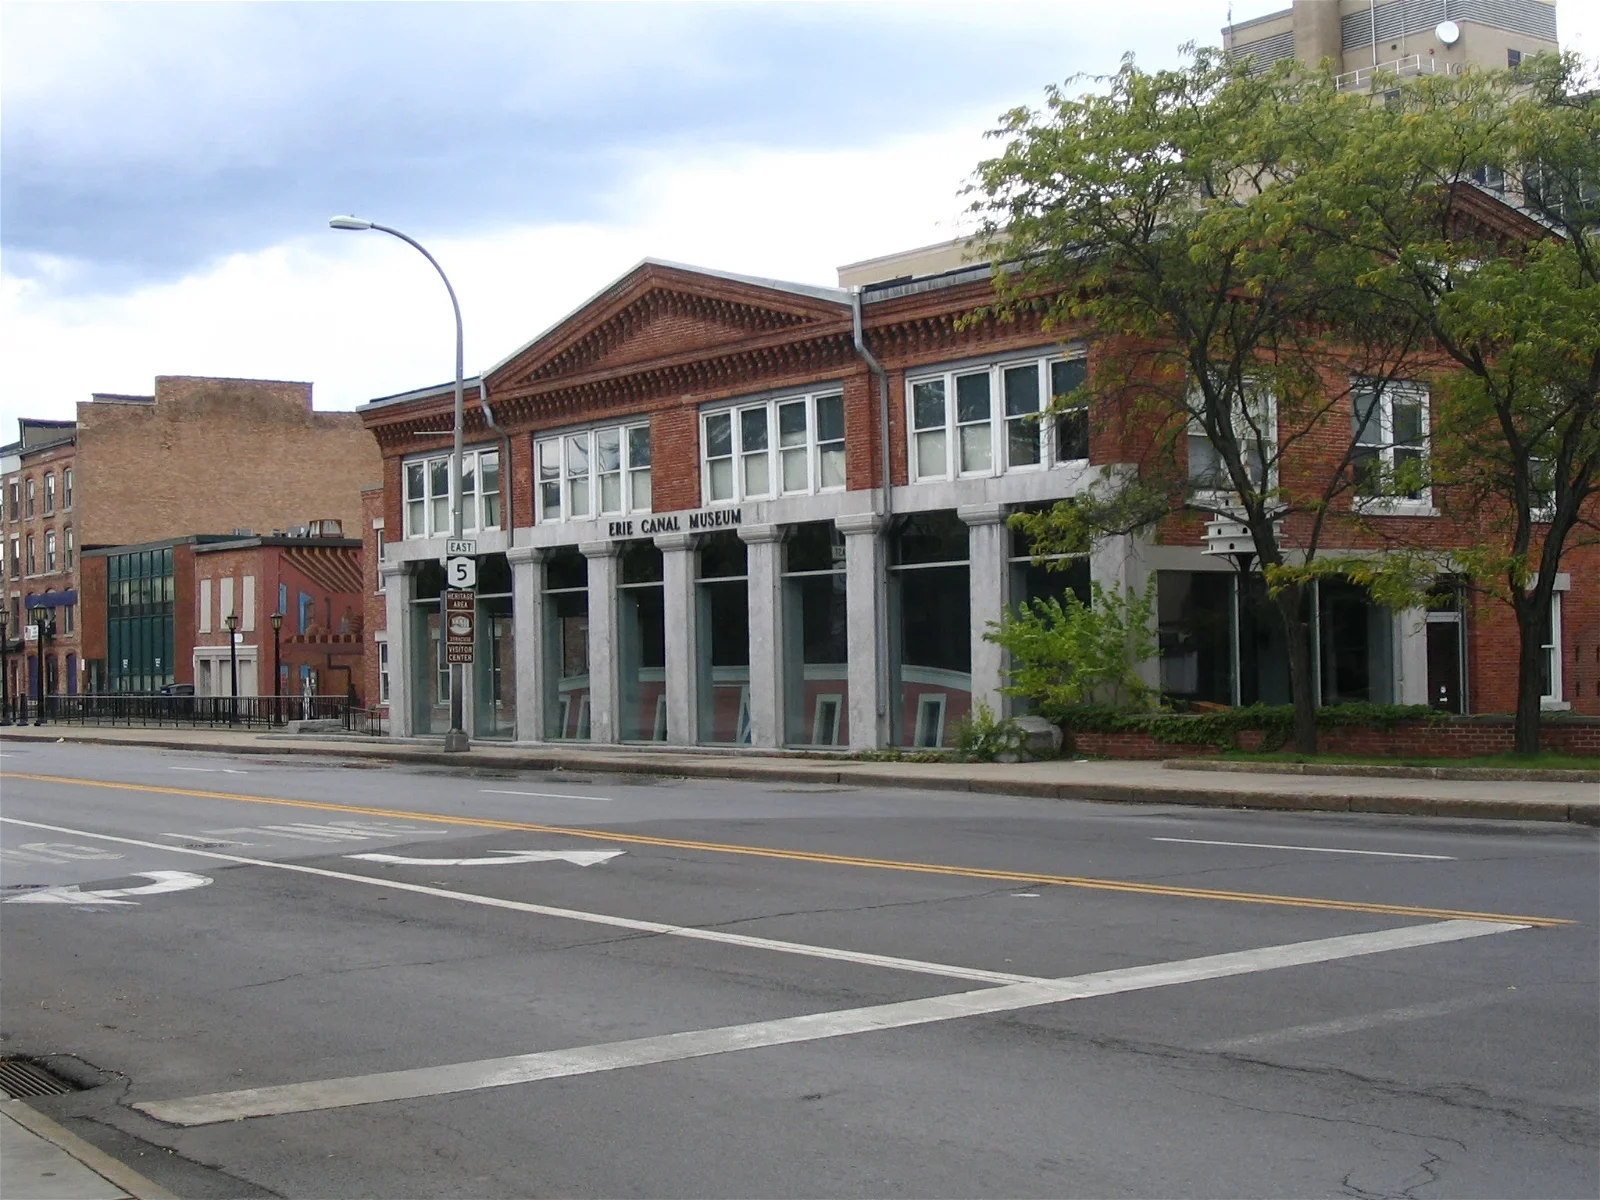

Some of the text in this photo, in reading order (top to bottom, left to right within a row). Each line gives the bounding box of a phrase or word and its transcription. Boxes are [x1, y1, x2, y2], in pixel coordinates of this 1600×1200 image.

[609, 508, 741, 537] ERIE CANAL MUSEUM
[451, 542, 472, 552] EAST
[457, 564, 467, 581] 5
[449, 654, 473, 662] CENTER
